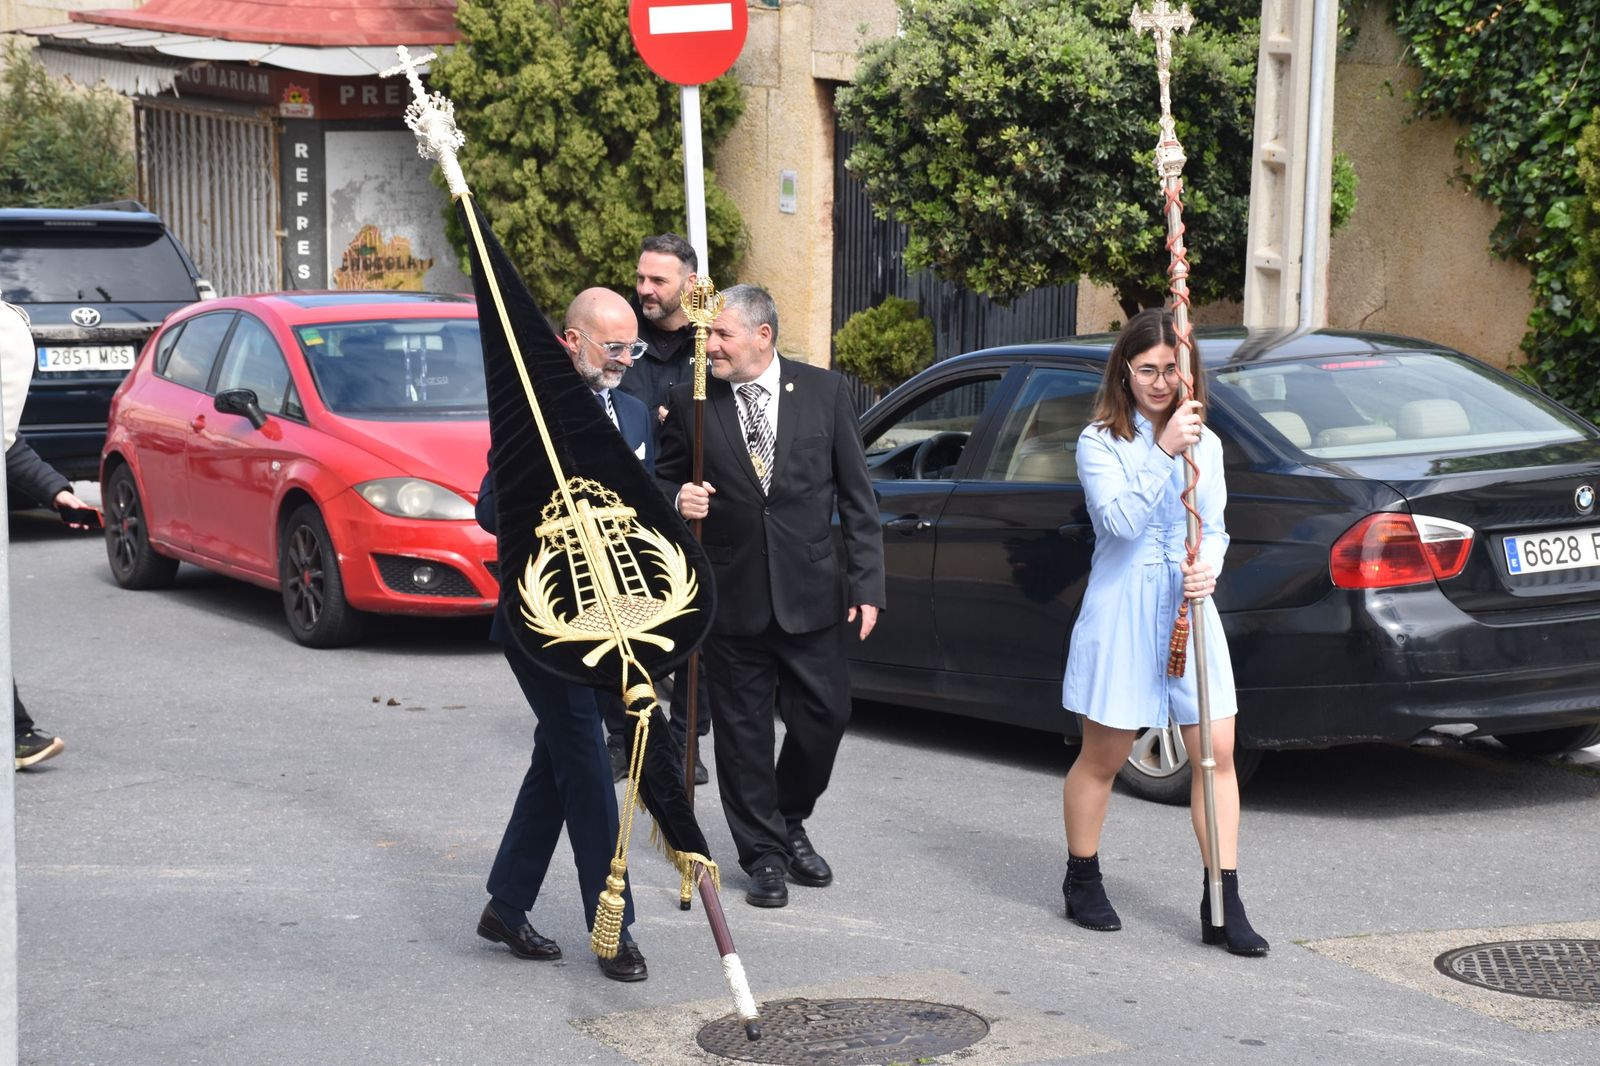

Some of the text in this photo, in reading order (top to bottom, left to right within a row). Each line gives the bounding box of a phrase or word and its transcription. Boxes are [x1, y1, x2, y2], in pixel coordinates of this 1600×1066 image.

[206, 65, 269, 95] MARIAM
[294, 142, 311, 280] REFRES
[52, 348, 129, 366] 2851 MGS
[1524, 535, 1582, 567] 6628
